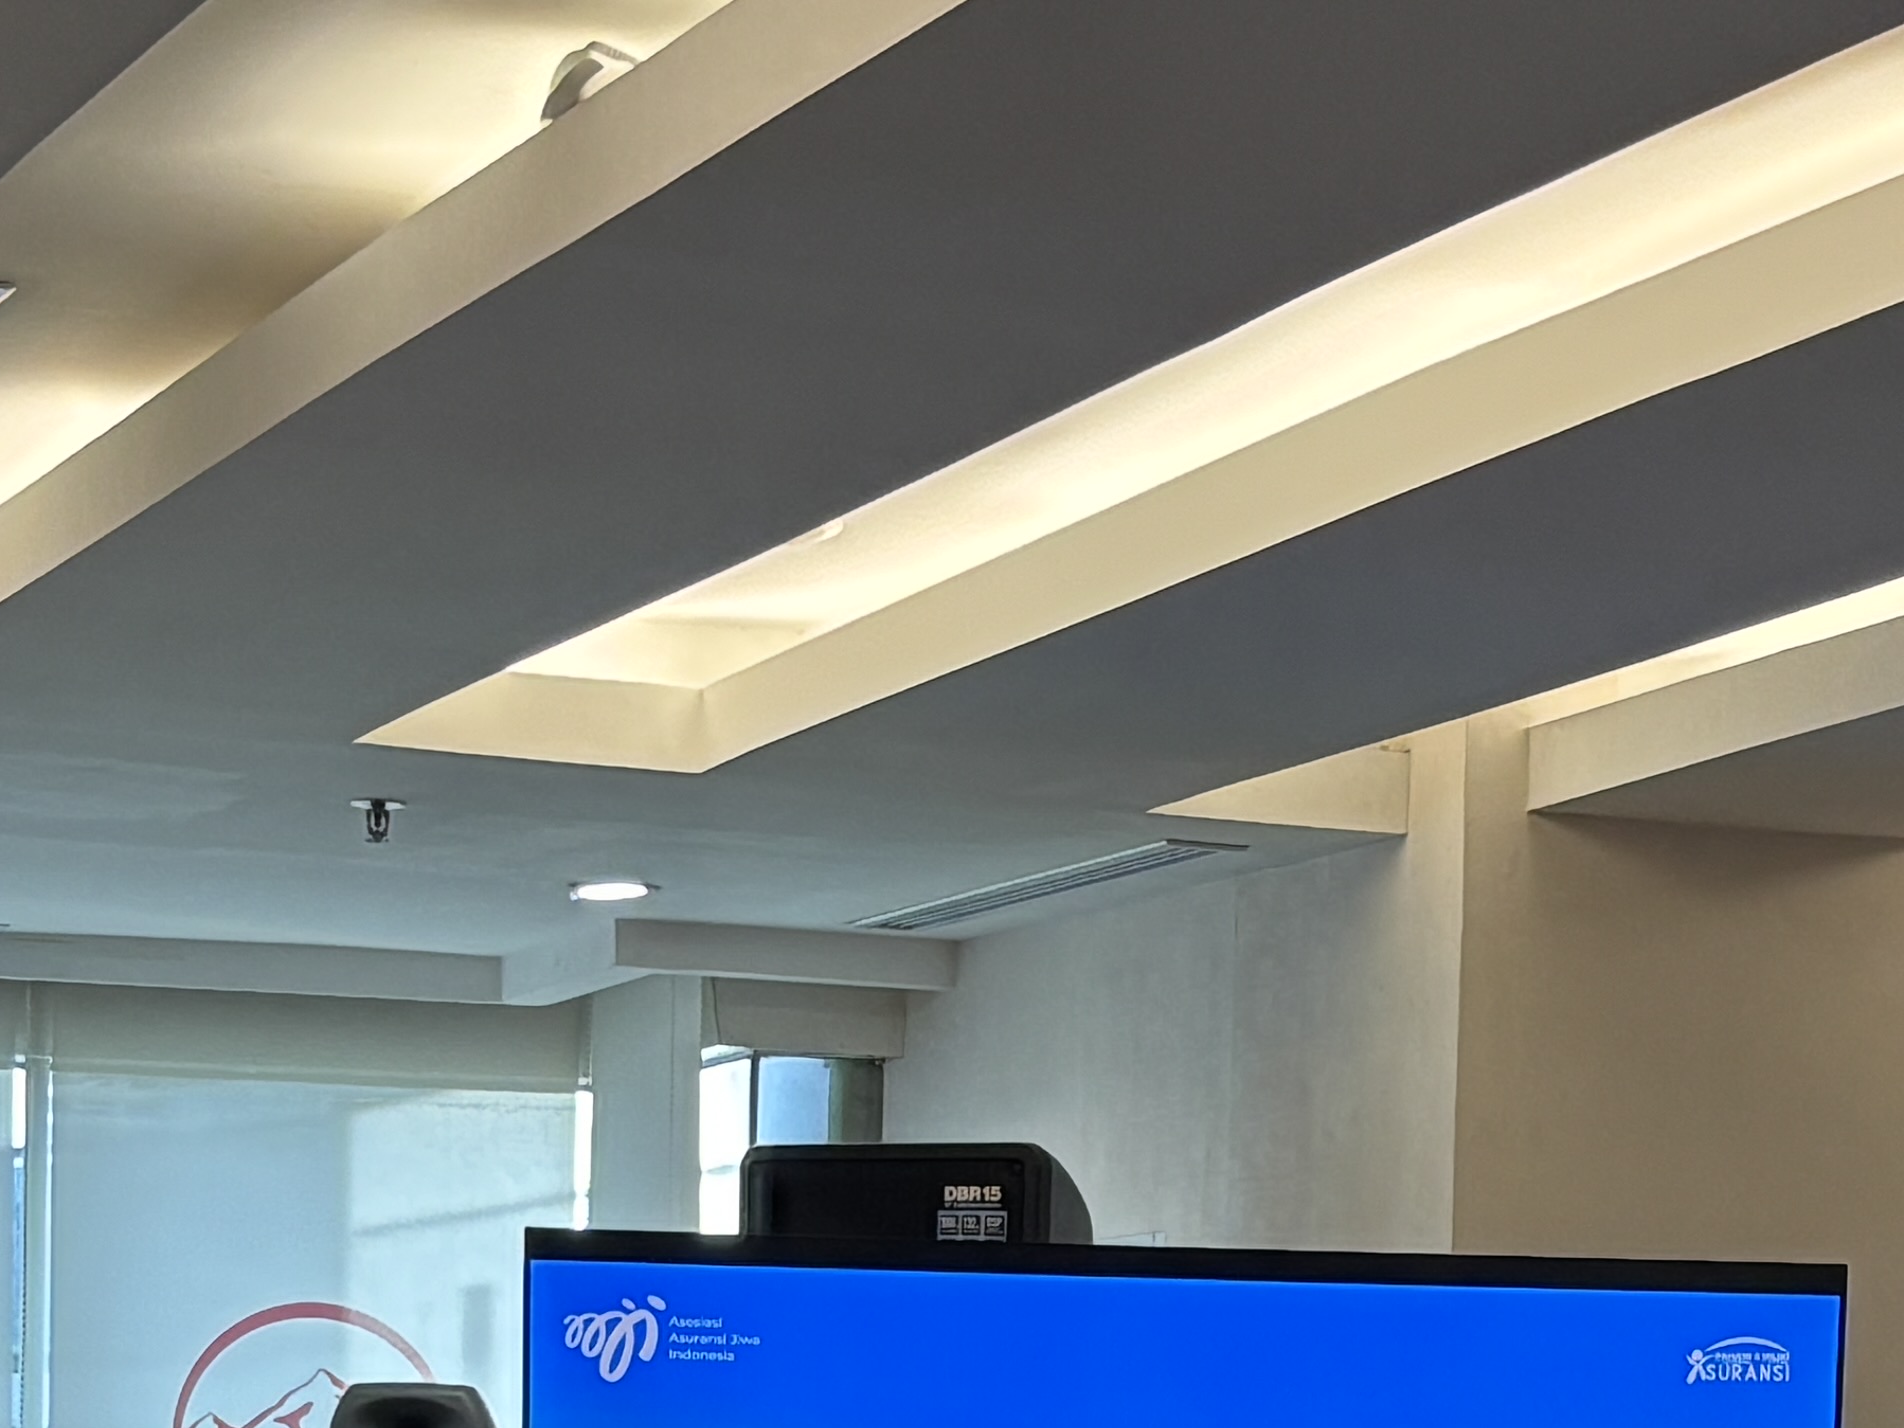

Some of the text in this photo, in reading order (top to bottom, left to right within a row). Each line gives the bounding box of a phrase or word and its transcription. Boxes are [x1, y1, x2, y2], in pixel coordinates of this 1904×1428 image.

[668, 1315, 723, 1328] Asosiasi
[668, 1332, 727, 1346] Asuransi
[668, 1348, 736, 1362] Indonesia
